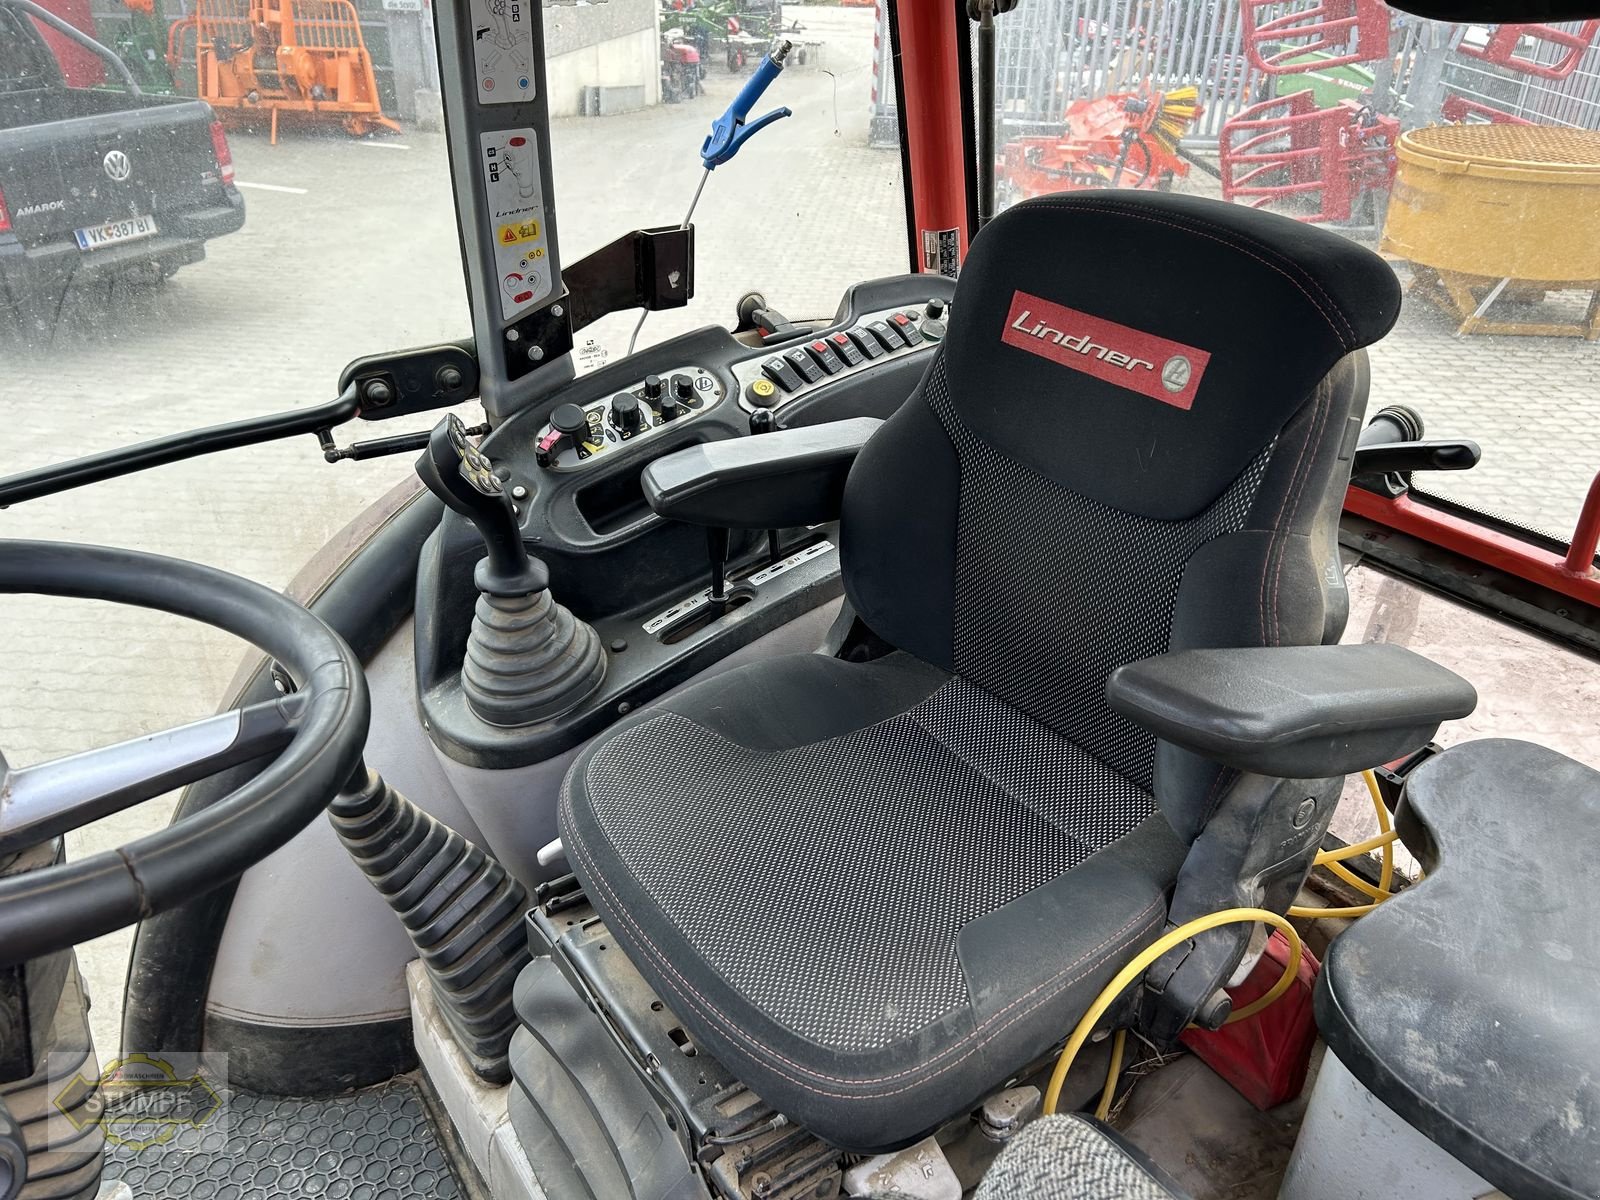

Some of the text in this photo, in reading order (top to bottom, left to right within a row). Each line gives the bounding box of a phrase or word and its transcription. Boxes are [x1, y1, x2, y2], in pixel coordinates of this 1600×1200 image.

[16, 199, 65, 217] AMAROK
[495, 205, 539, 218] Lindner
[88, 227, 107, 243] VK
[112, 220, 134, 238] 387
[1010, 310, 1155, 372] Lindner
